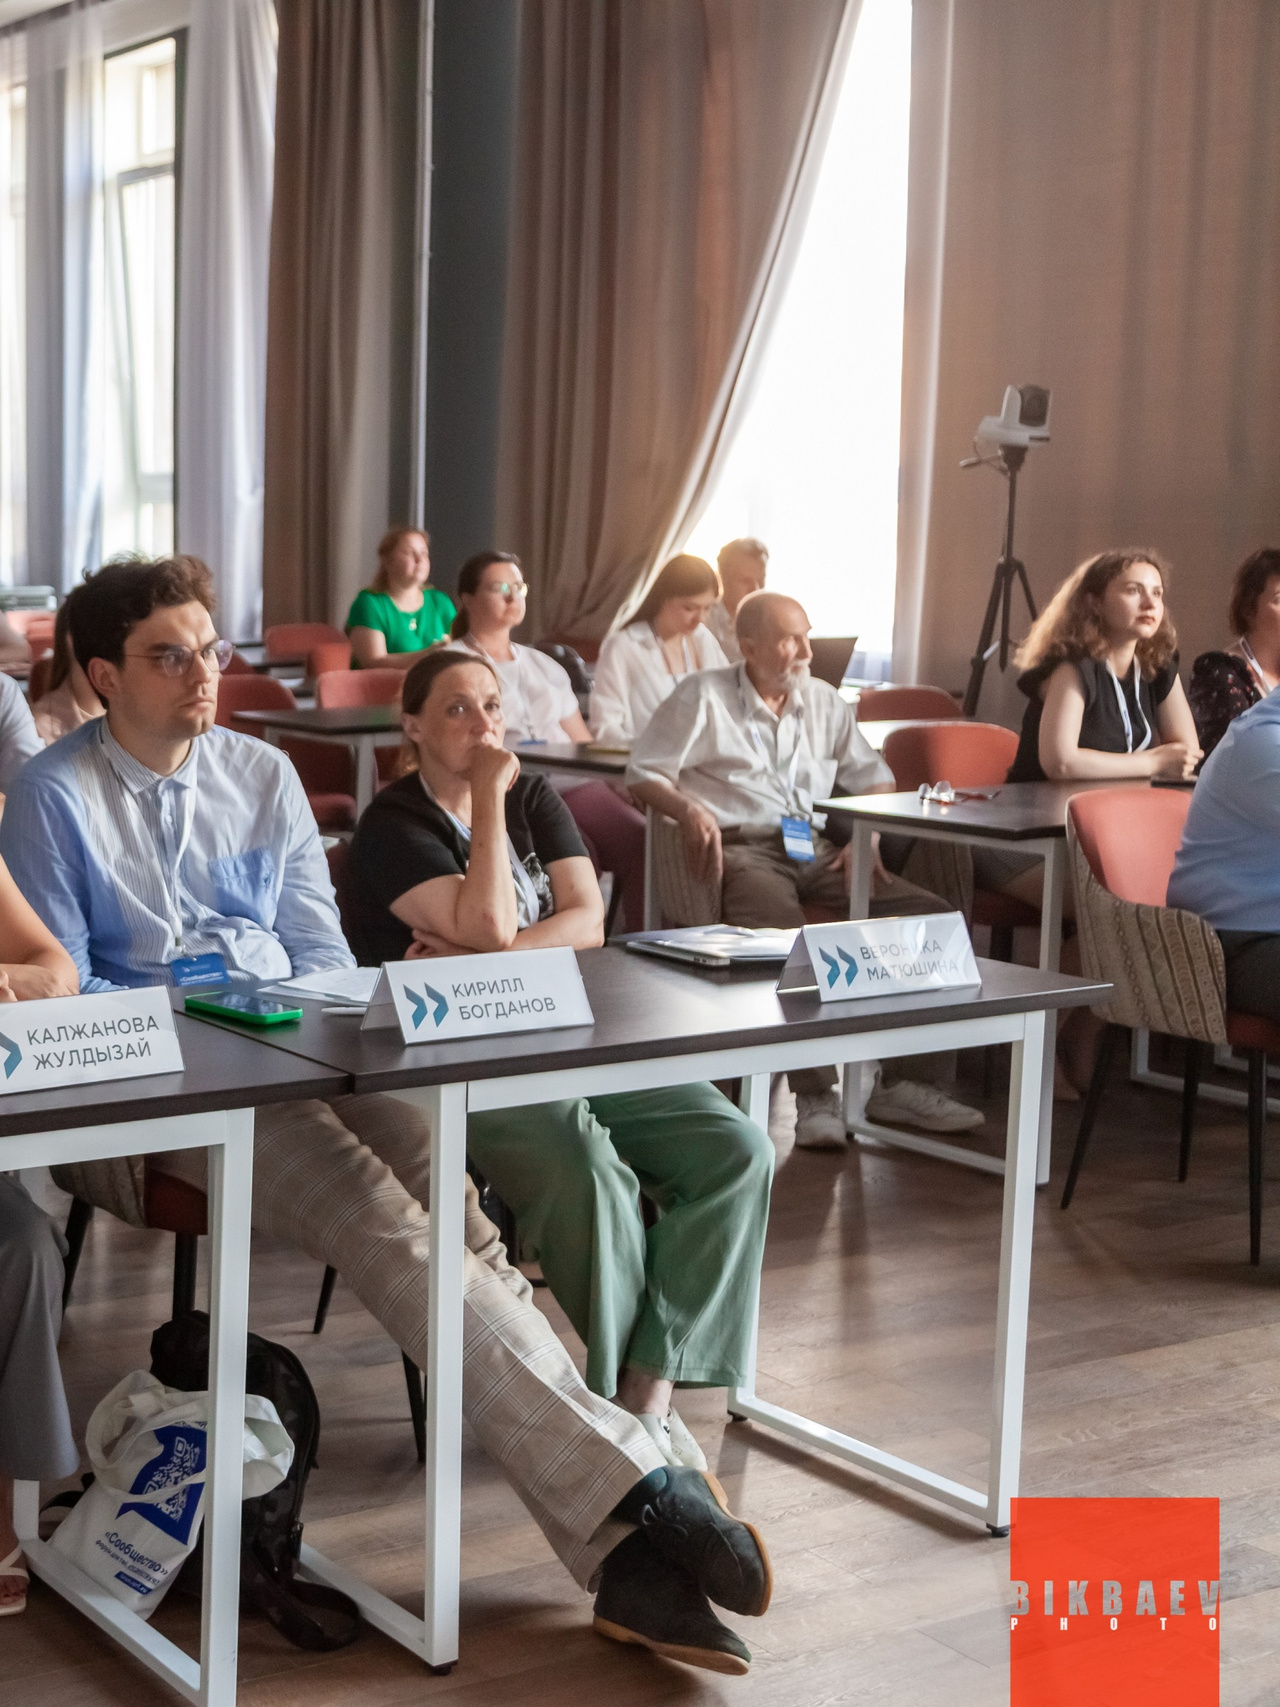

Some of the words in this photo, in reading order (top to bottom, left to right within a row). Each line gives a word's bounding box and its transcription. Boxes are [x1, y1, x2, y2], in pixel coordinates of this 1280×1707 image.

[866, 959, 959, 981] МАТЮШИНА
[451, 977, 525, 998] КИРИЛЛ
[458, 997, 556, 1020] БОГДАНОВ
[26, 1015, 160, 1045] КАЛЖАНОВА
[32, 1037, 152, 1071] ЖУЛДЫЗАЙ
[105, 1531, 168, 1575] «Сообщество»
